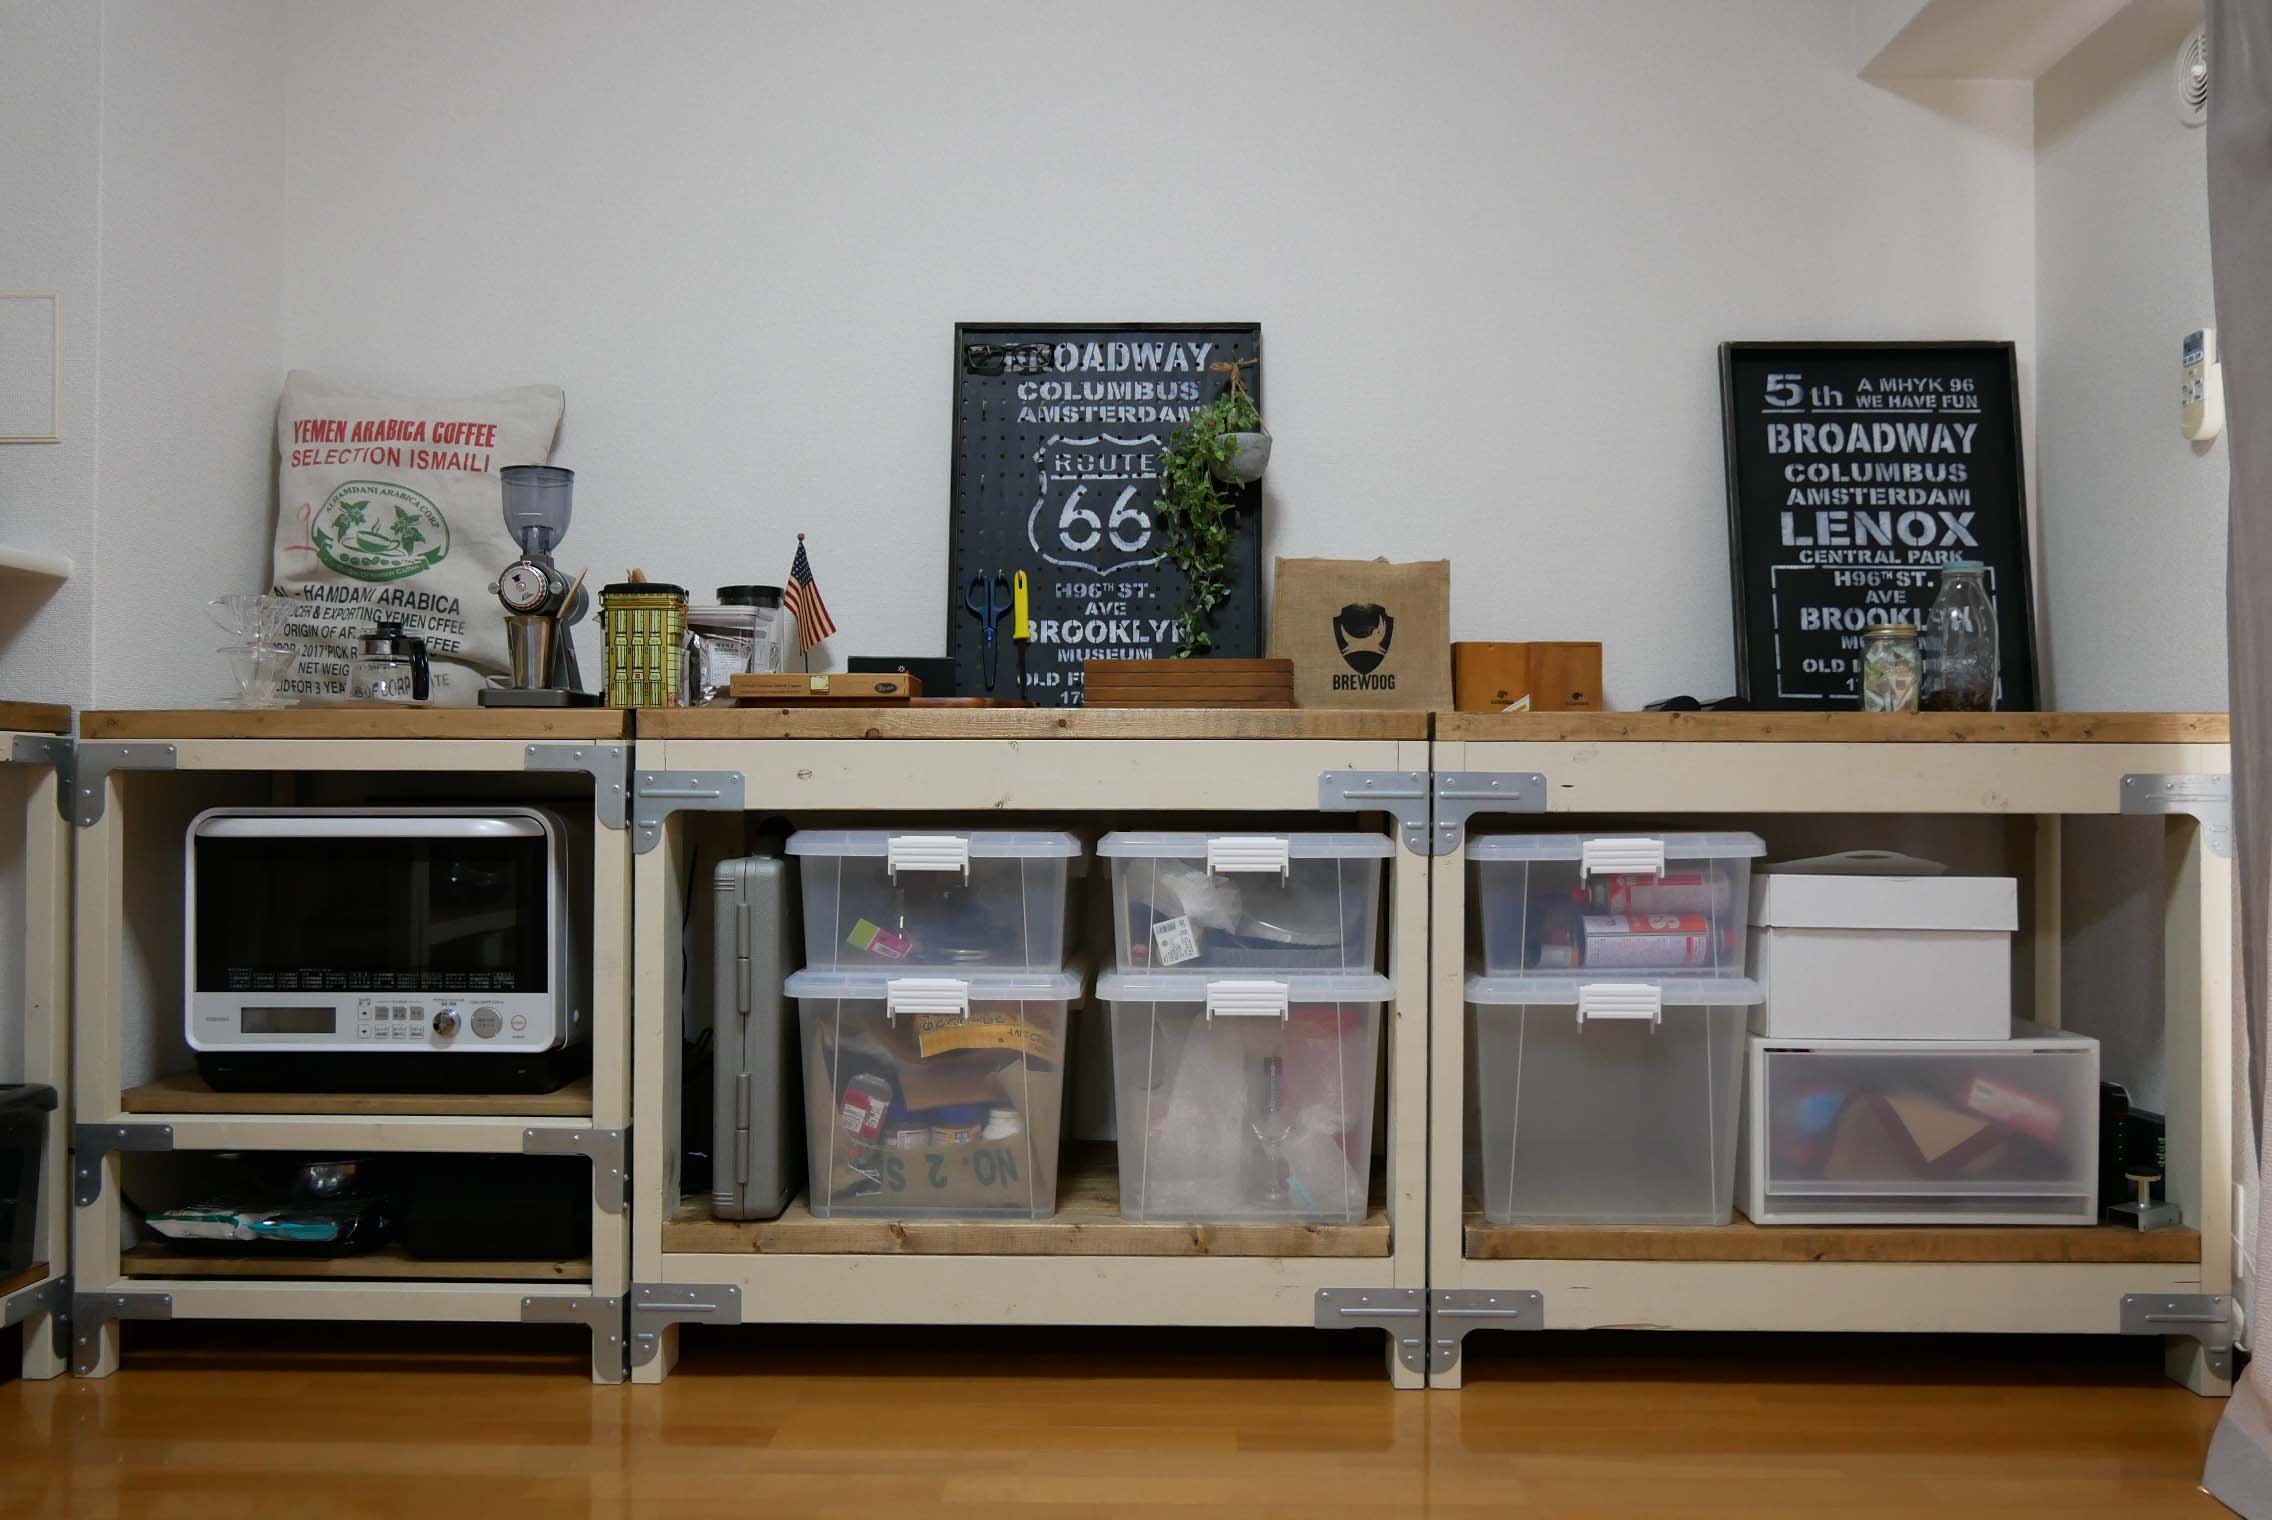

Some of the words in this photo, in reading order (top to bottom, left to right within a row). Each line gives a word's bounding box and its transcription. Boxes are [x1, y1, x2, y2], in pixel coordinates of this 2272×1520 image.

[1004, 341, 1214, 373] BROADWAY
[1017, 381, 1200, 401] COLUMBUS
[1857, 377, 1874, 393] A
[1879, 377, 1944, 393] MHYK
[1949, 377, 1975, 393] 96
[1855, 394, 1884, 409] WE
[1888, 394, 1937, 409] HAVE
[1942, 394, 1979, 410] FUN
[1017, 404, 1201, 424] AMSTERDAM
[293, 418, 347, 444] YEMEN
[351, 418, 427, 443] ARABICA
[432, 421, 498, 449] COFFEE
[1767, 422, 1979, 454] BROADWAY
[291, 446, 401, 469] SELECTION
[409, 447, 491, 473] ISMAILI
[1054, 452, 1155, 473] ROUTE
[1784, 462, 1969, 483] COLUMBUS
[1786, 488, 1971, 507] AMSTERDAM
[419, 505, 441, 529] CORP
[1058, 484, 1152, 552] 66
[1780, 510, 1980, 548] LENOX
[1799, 549, 1902, 565] CENTRAL
[1907, 549, 1963, 564] PARK
[1896, 571, 1934, 588] ST.
[303, 584, 377, 604] HAMDANI
[376, 587, 461, 616] ARABICA
[1117, 582, 1156, 599] ST.
[1865, 590, 1907, 604] AVE
[312, 606, 321, 620] &
[321, 606, 382, 625] EXPORTING
[385, 610, 427, 630] YEMEN
[1084, 601, 1128, 616] AVE
[283, 623, 319, 639] ORIGIN
[320, 625, 338, 639] OF
[1026, 619, 1188, 644] BROOKLYN
[1057, 648, 1153, 662] MUSEUM
[297, 661, 320, 675] NET
[1802, 658, 1846, 673] OLD
[291, 679, 313, 694] FOR
[1017, 672, 1061, 687] OLD
[1332, 674, 1396, 691] BREWDOG
